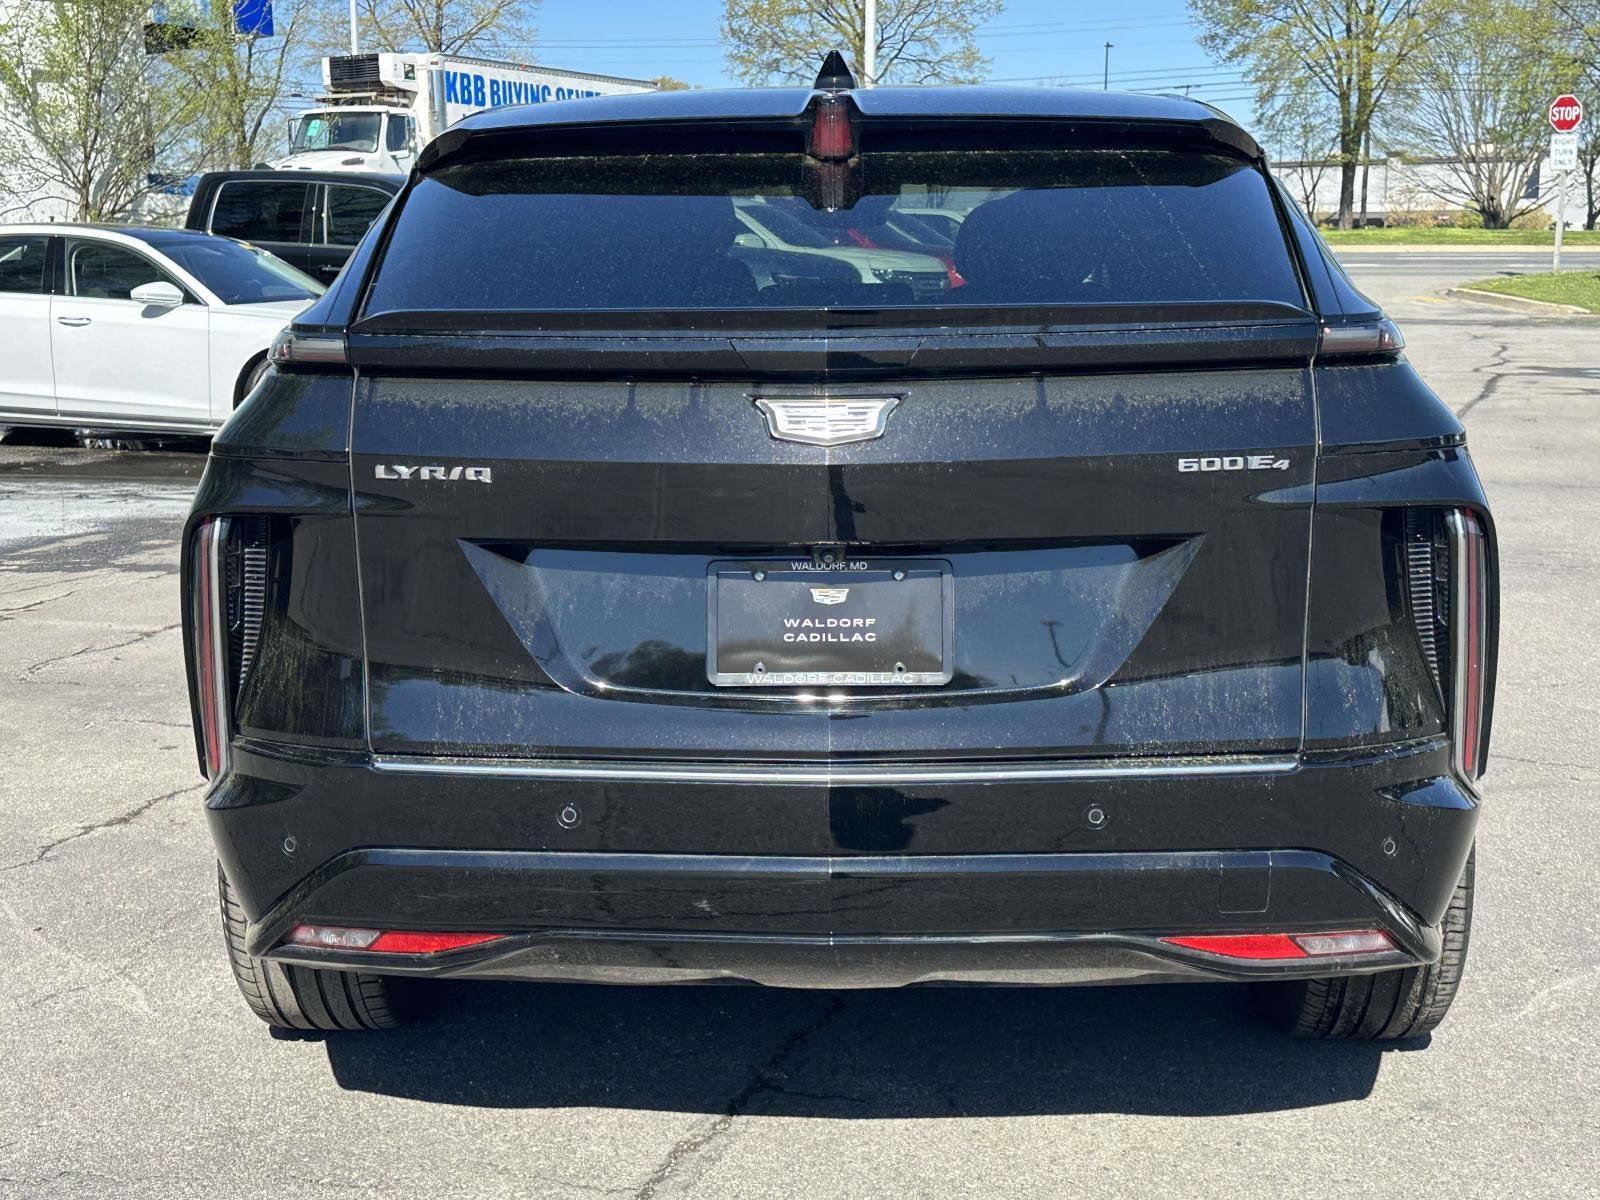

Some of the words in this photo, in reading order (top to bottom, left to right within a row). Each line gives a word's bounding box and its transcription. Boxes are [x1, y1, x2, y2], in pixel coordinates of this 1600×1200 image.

[444, 70, 486, 107] KBB
[489, 78, 551, 107] BUYING
[1551, 106, 1580, 121] STOP
[1554, 148, 1574, 156] TURN
[1553, 158, 1573, 166] ONLY
[850, 561, 868, 570] MD
[783, 618, 876, 628] WALDORF
[783, 632, 877, 642] CADILLAC
[746, 674, 827, 684] WALDORF
[832, 674, 914, 684] CADILLAC
